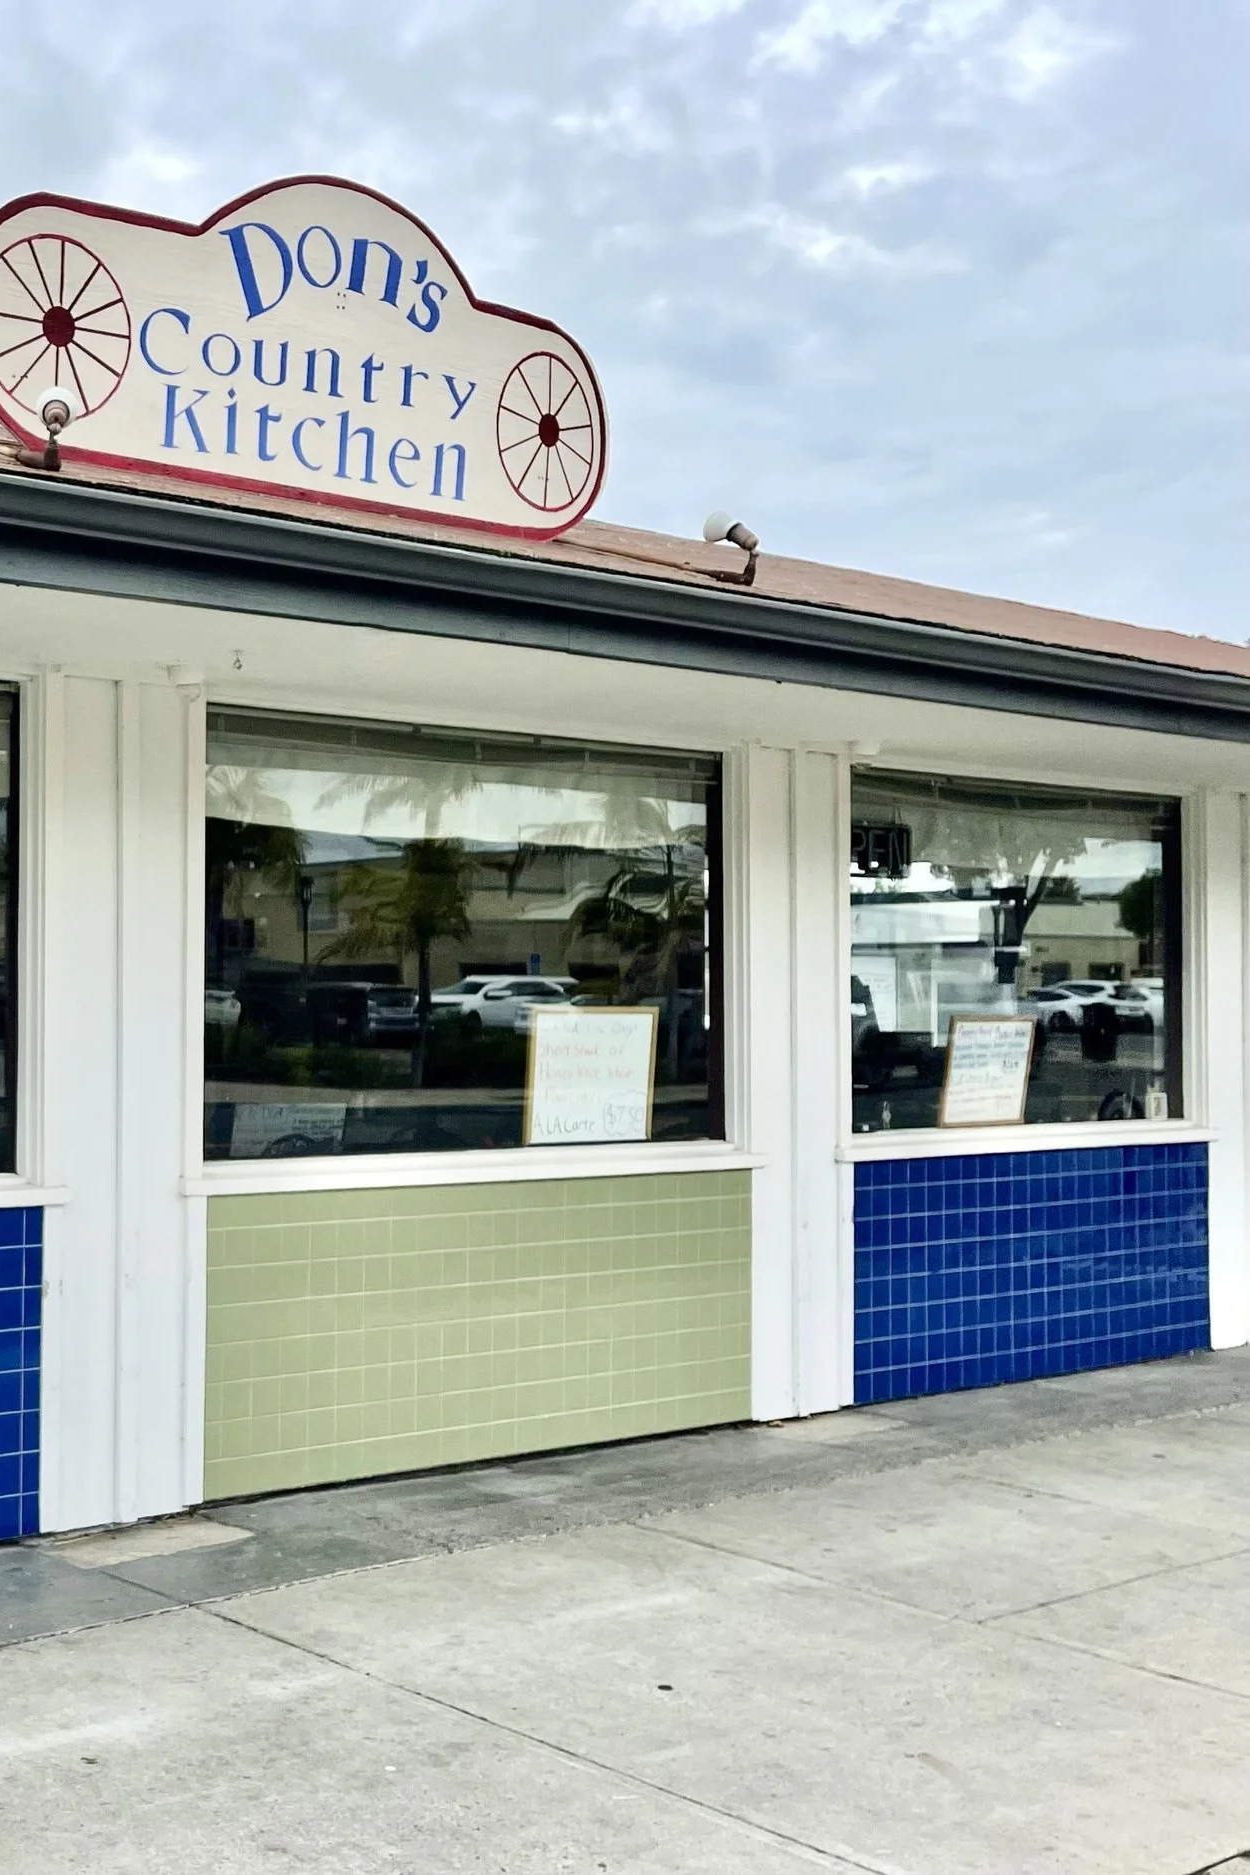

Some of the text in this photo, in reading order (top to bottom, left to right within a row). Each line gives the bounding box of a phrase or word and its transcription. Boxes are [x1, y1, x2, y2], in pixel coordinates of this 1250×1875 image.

[218, 221, 448, 333] Don's
[139, 307, 477, 420] Country
[160, 382, 467, 501] Kitchen
[852, 828, 907, 870] PEN
